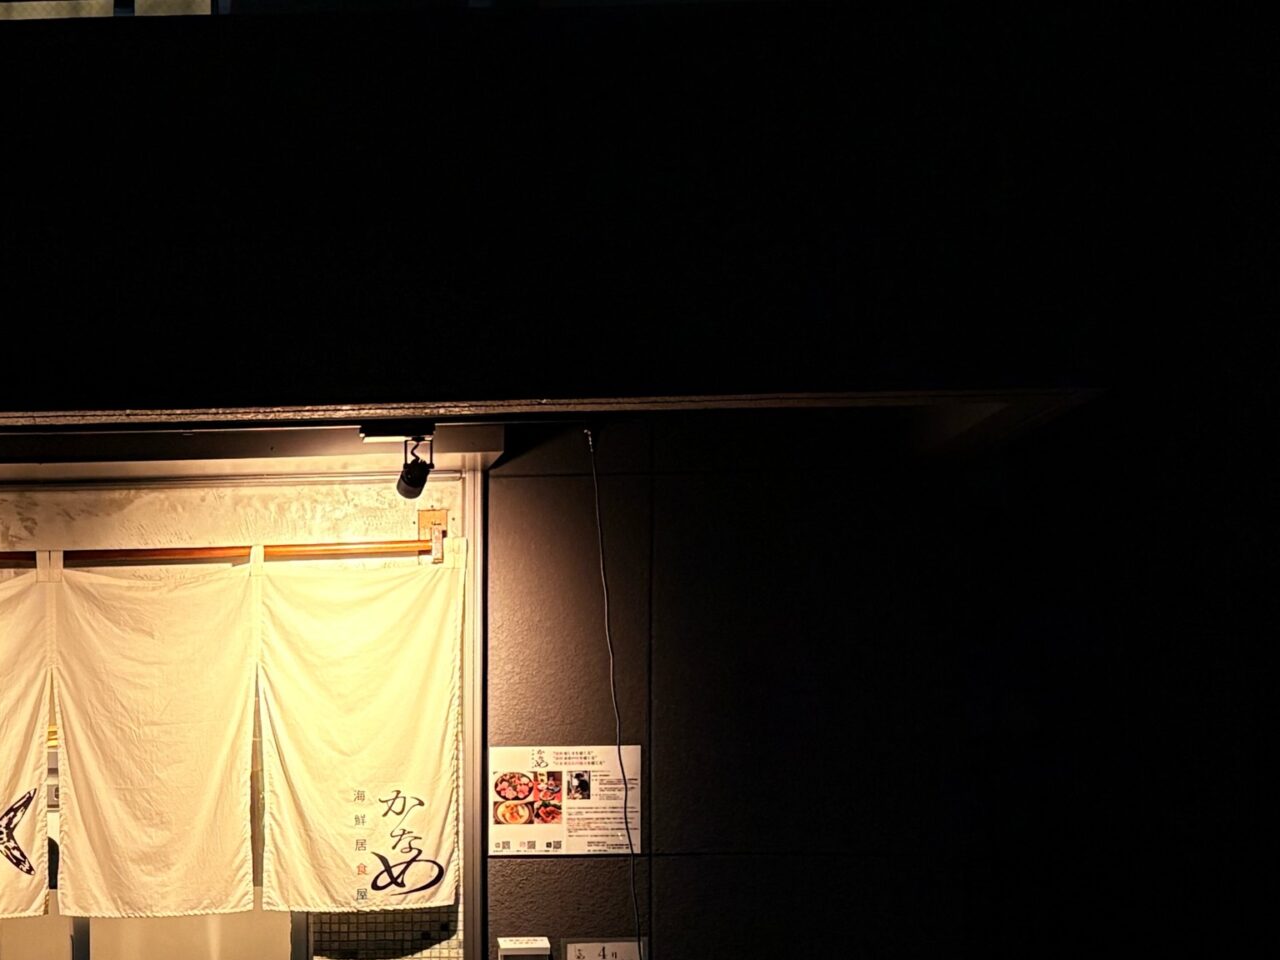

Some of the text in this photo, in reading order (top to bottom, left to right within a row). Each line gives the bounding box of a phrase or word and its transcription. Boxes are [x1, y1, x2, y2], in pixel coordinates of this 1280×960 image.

[353, 789, 368, 900] 海鮮居食屋
[371, 789, 445, 896] かなめ
